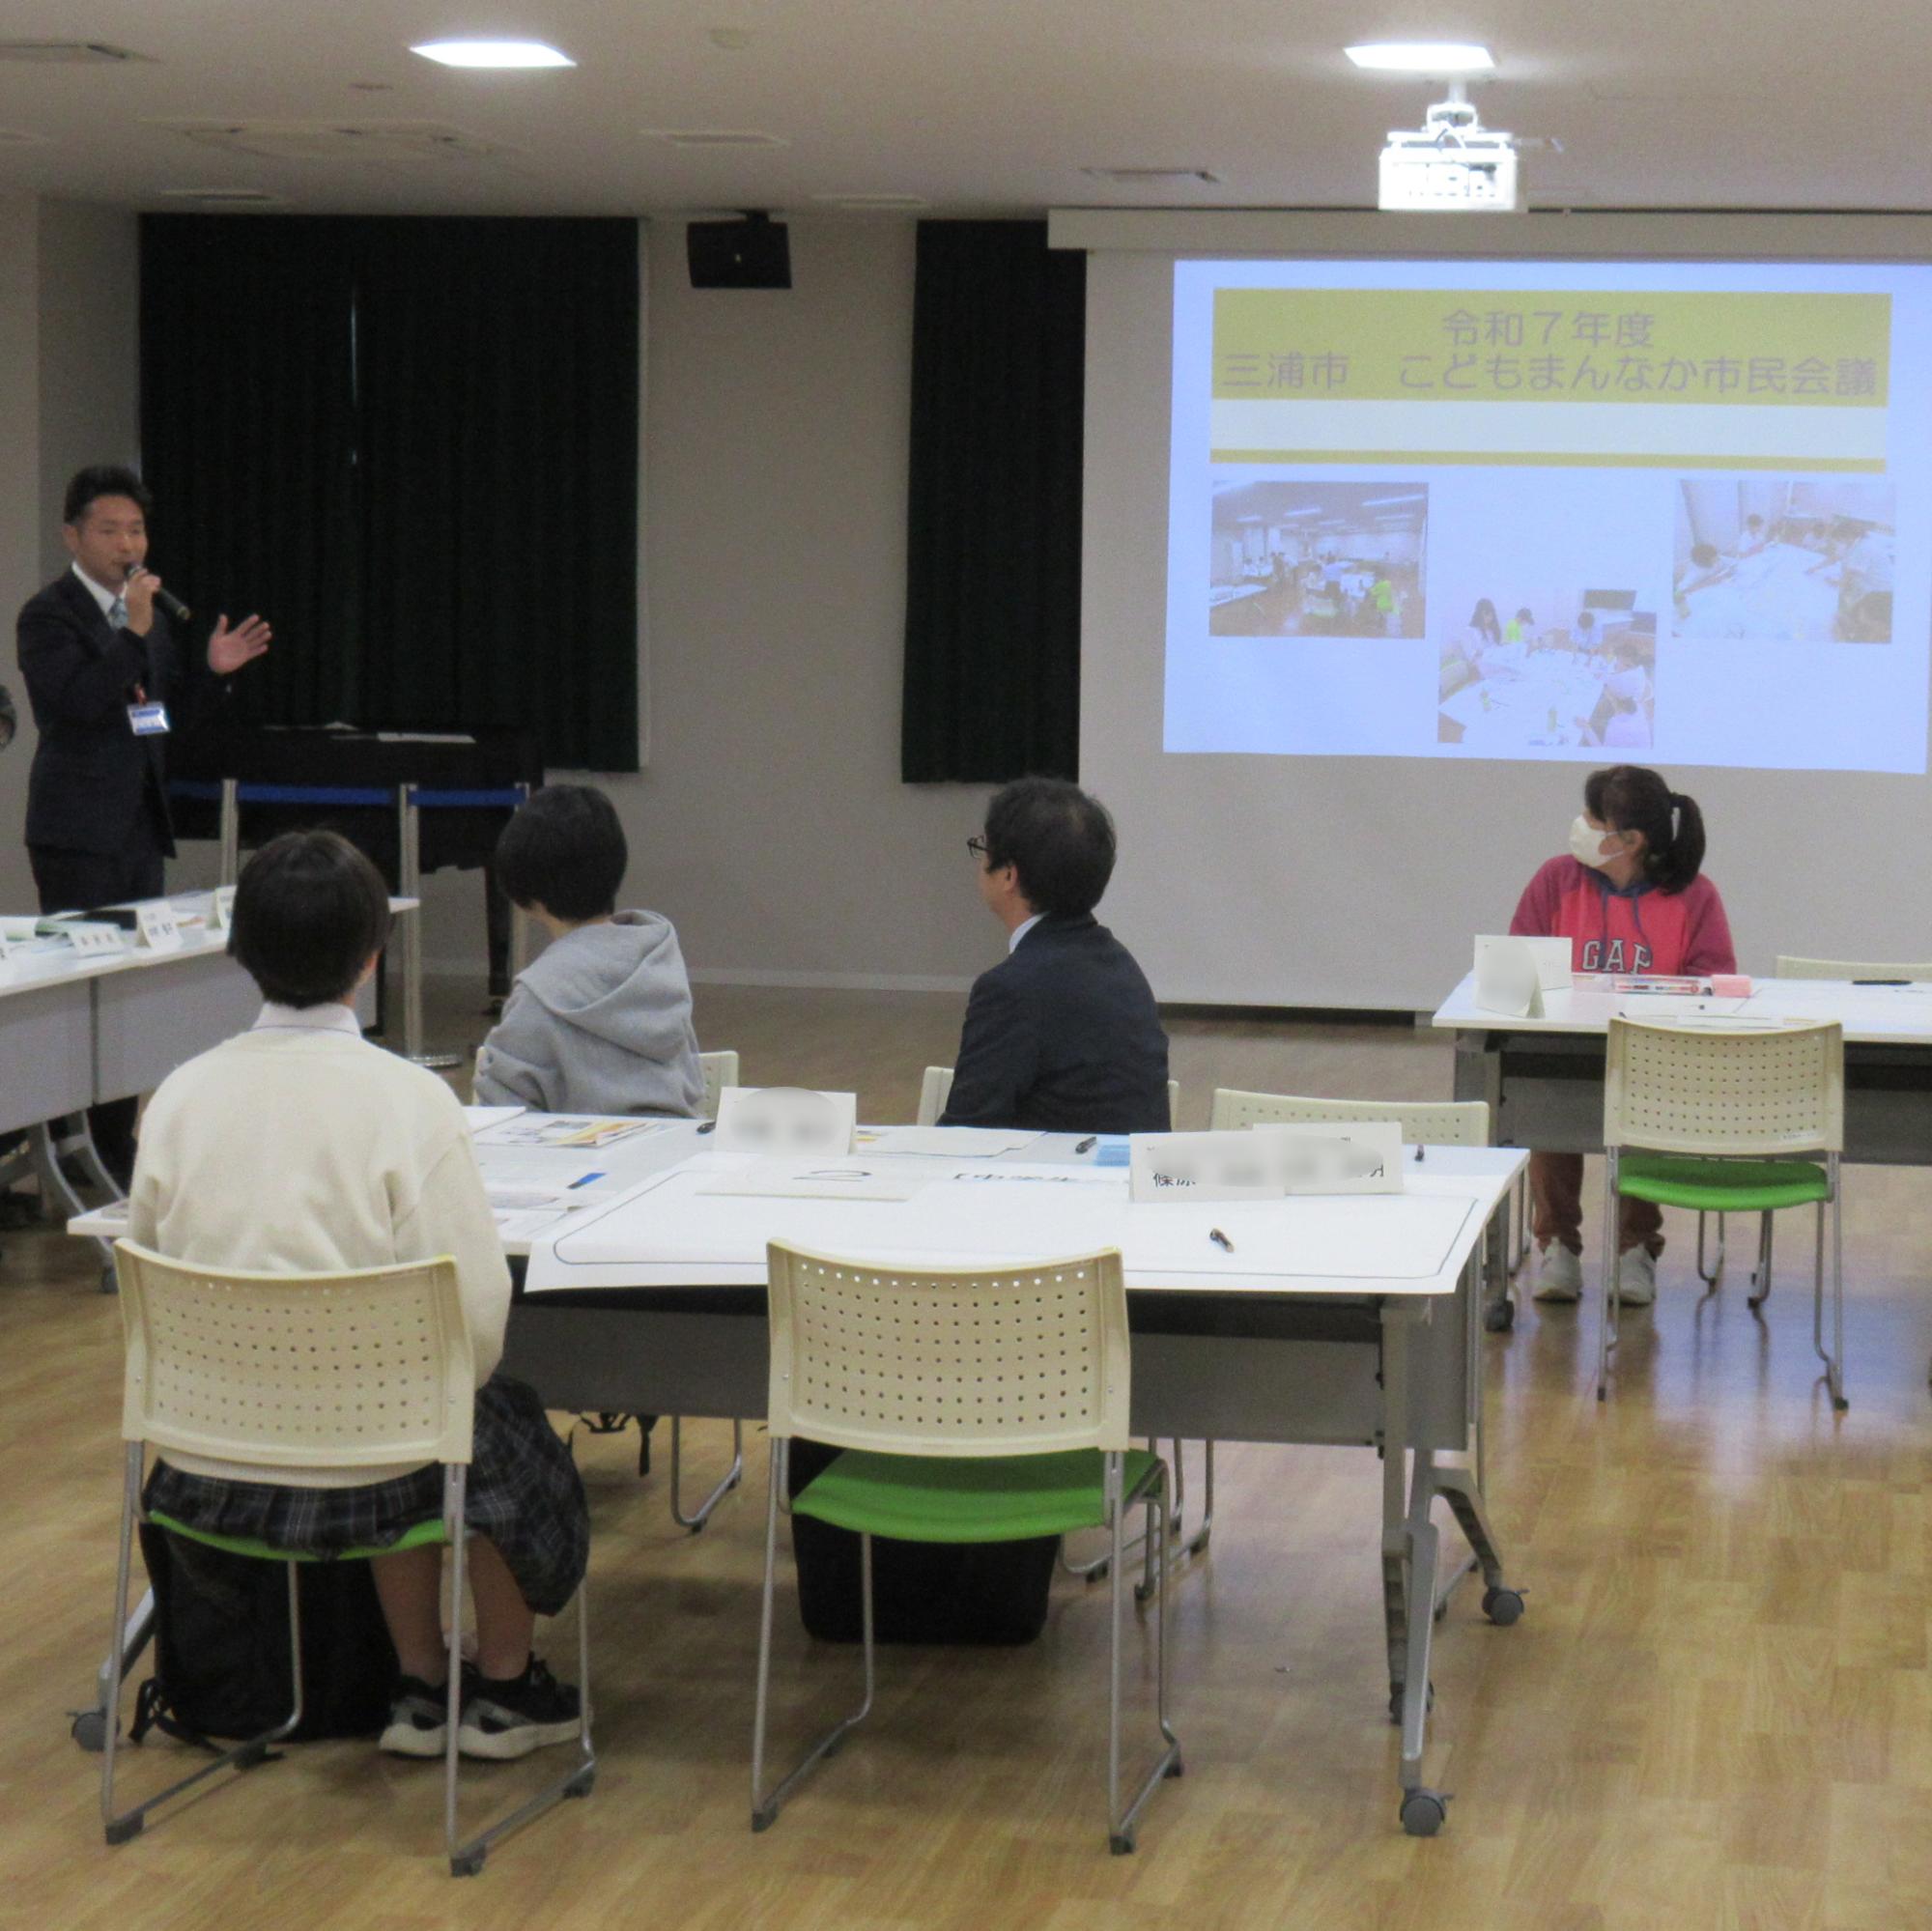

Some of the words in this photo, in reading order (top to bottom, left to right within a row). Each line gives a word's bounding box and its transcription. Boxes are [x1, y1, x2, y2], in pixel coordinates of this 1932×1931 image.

[1442, 308, 1655, 349] 令和7年度
[1222, 351, 1350, 389] 三浦市
[1400, 353, 1877, 397] こどもまんなか市民会議
[1581, 939, 1651, 976] GAP
